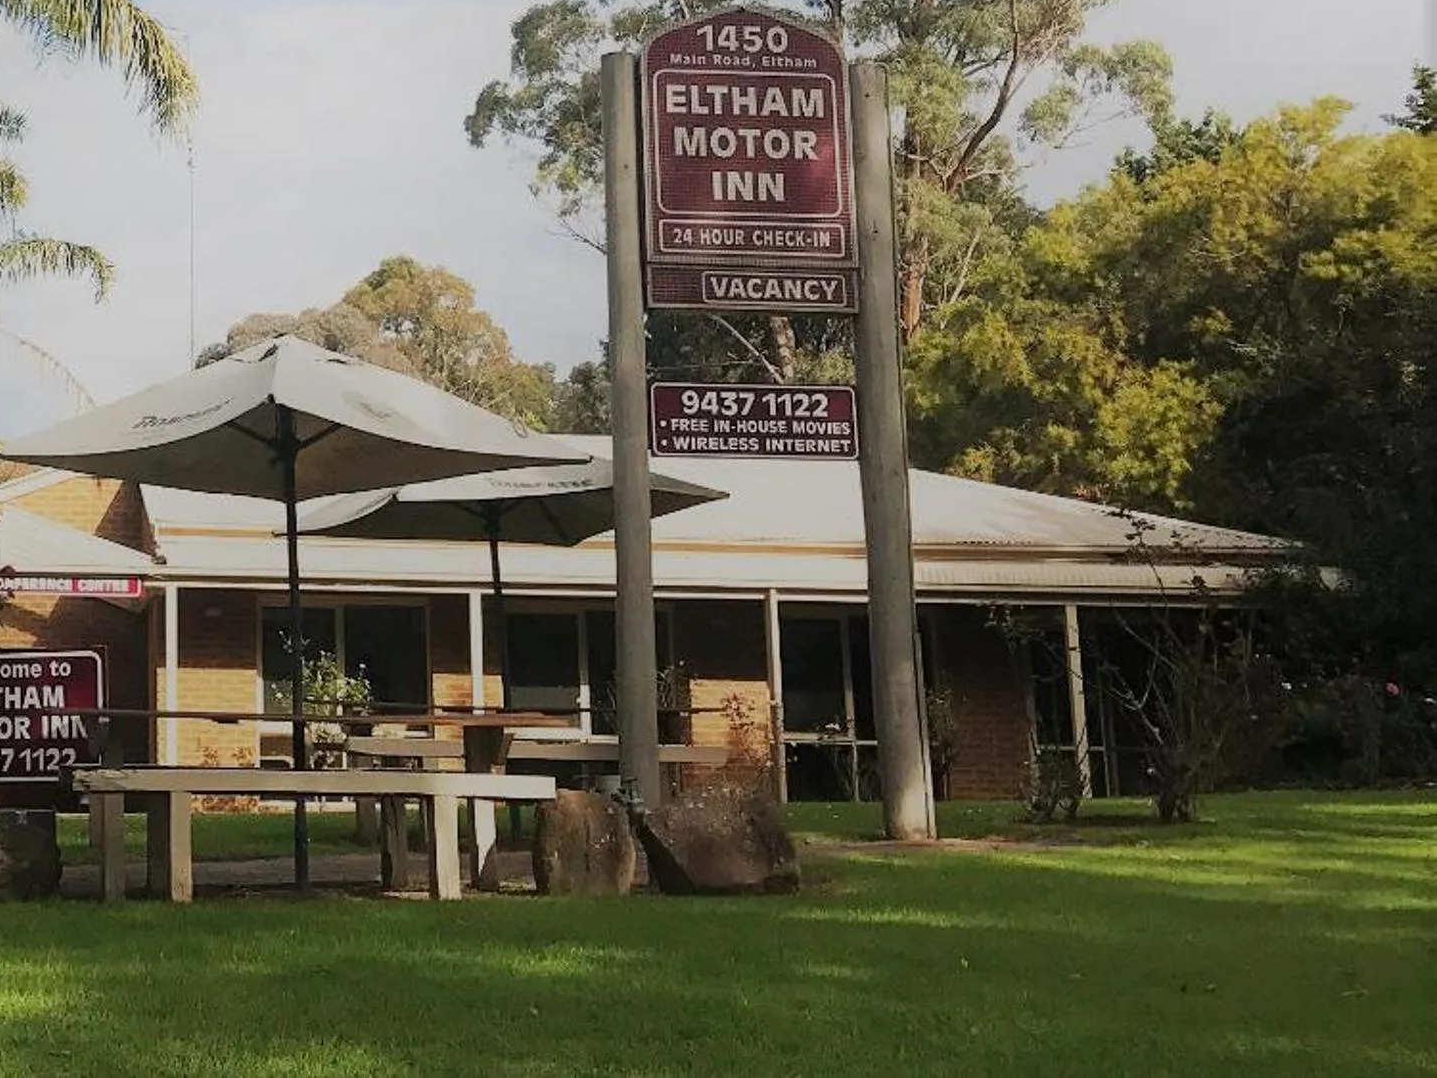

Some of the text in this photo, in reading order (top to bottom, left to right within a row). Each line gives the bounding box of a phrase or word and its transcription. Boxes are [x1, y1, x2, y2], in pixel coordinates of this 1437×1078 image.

[696, 25, 789, 54] 1450
[669, 54, 818, 69] Main Road, Eltham
[665, 84, 825, 119] ELTHAM
[673, 126, 819, 161] MOTOR
[711, 170, 786, 202] INN
[672, 228, 831, 248] 24 HOUR CHECK-IN
[709, 276, 839, 302] VACANCY
[681, 390, 829, 418] 9437 1122
[670, 418, 851, 435] FREE IN-HOUSE MOVIES
[672, 437, 852, 453] WIRELESS INTERNET
[49, 660, 72, 677] to
[18, 747, 78, 772] 1122
